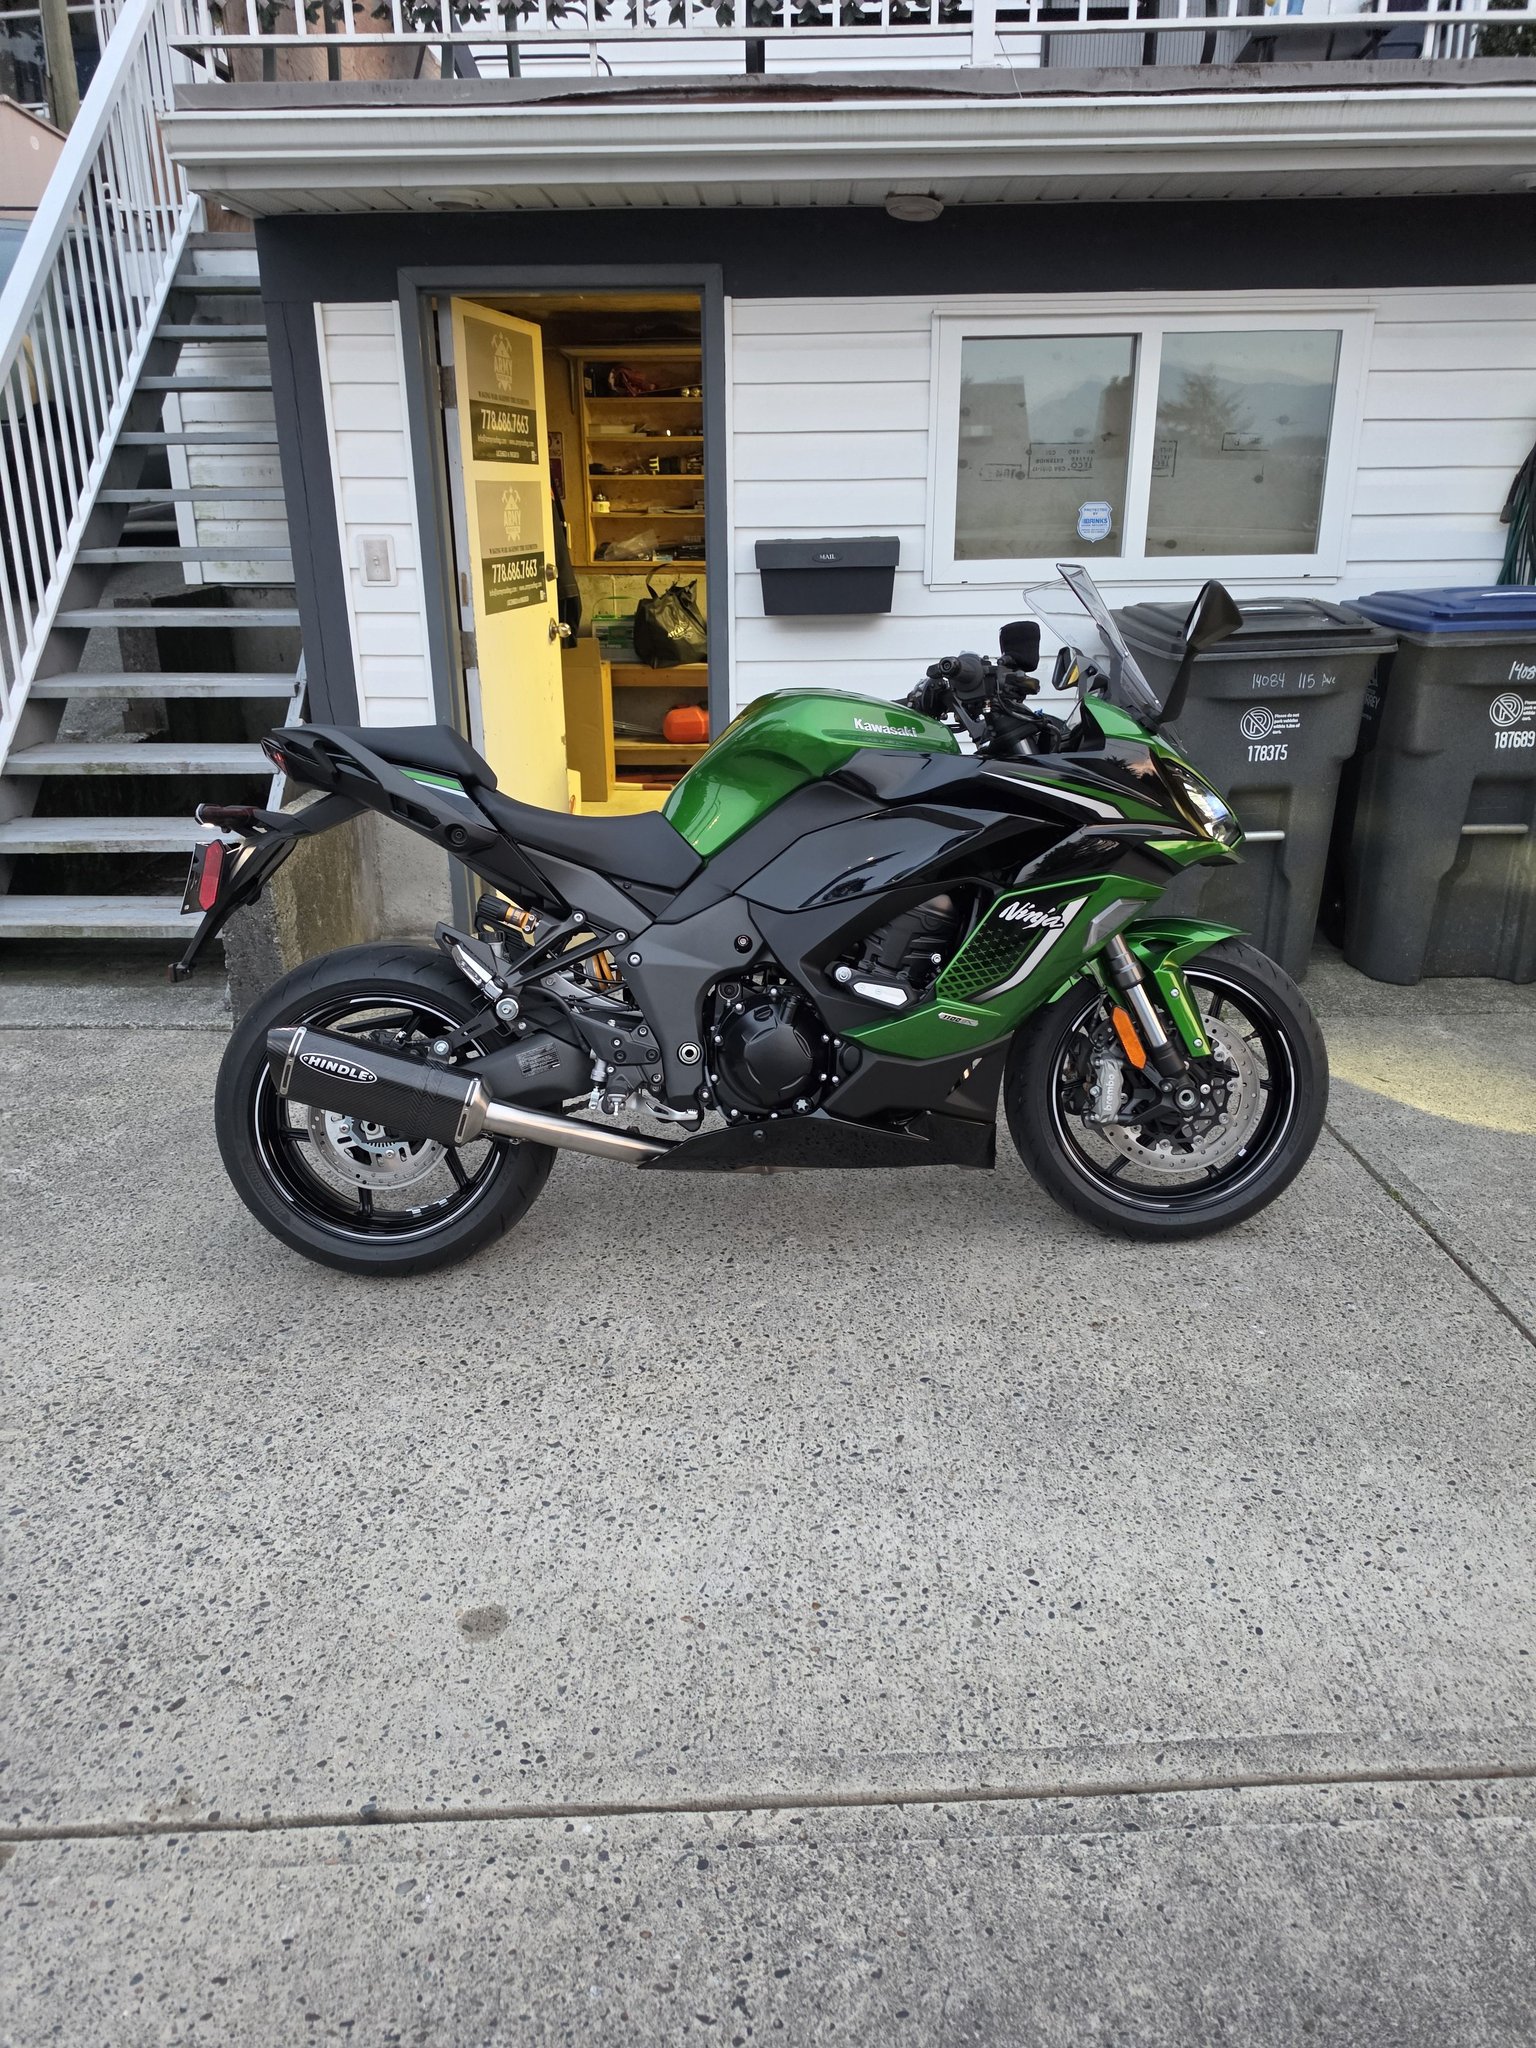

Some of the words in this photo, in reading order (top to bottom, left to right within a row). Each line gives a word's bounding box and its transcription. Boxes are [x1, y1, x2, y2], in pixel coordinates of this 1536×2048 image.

[494, 356, 513, 377] ARMY
[480, 408, 529, 434] 778.686.7663
[503, 510, 521, 527] ARMY
[491, 558, 538, 584] 778.686.7663
[1252, 672, 1285, 690] 14084
[1298, 672, 1316, 690] 115
[853, 717, 918, 738] Kawasaki
[1494, 730, 1536, 749] 187689
[1247, 744, 1289, 762] 178375
[998, 901, 1065, 930] Ninja
[308, 1055, 370, 1081] HINDLE
[1104, 1074, 1115, 1111] brembo
